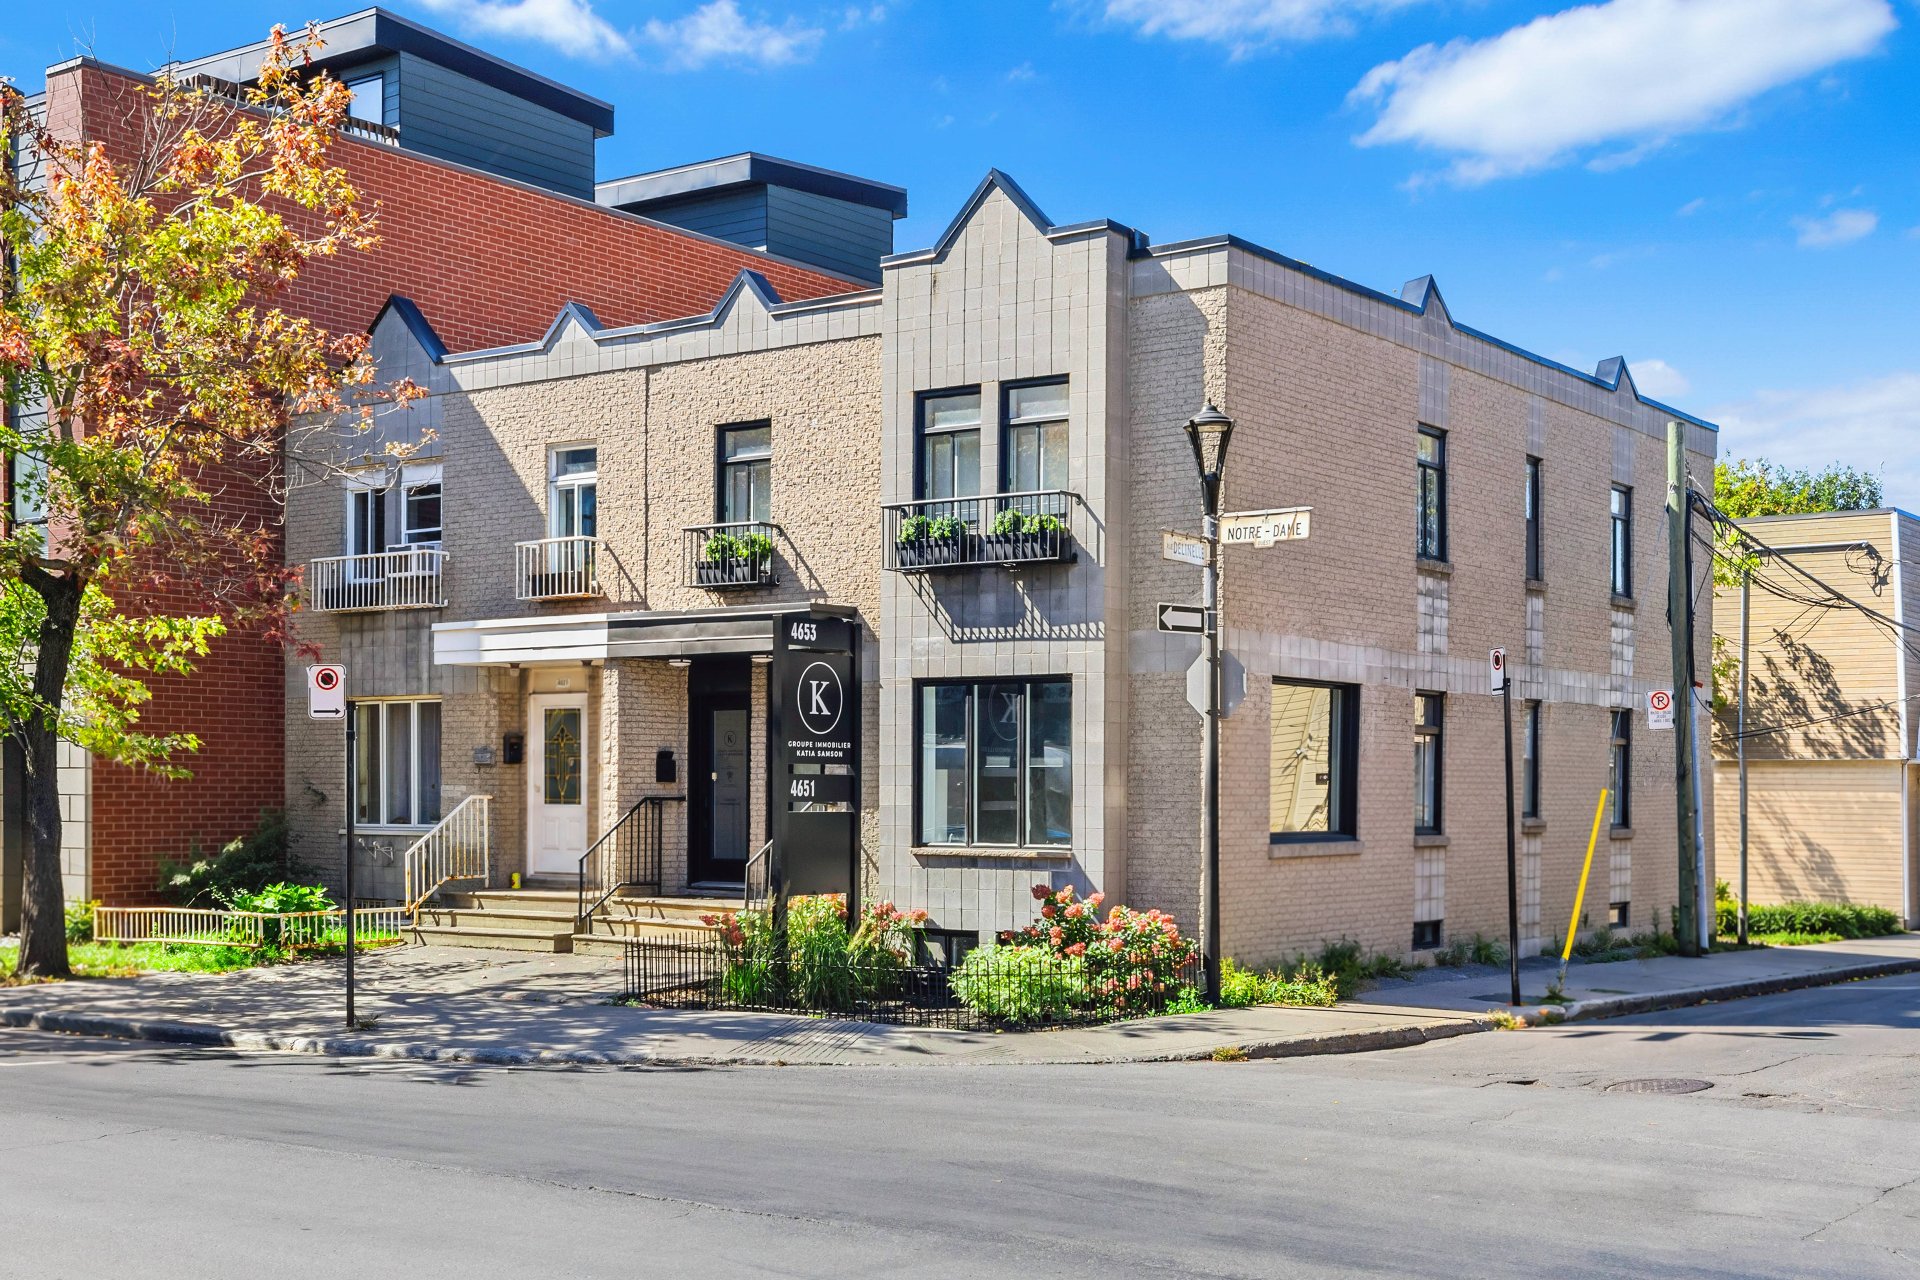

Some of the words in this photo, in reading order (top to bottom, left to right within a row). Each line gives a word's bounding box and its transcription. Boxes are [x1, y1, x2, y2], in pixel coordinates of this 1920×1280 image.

[791, 622, 817, 641] 4653
[809, 680, 831, 715] K
[787, 740, 813, 748] GROUPE
[815, 741, 851, 749] IMMOBILIER
[796, 749, 815, 757] KATIA
[817, 750, 843, 758] SAMSON
[790, 779, 815, 797] 4651
